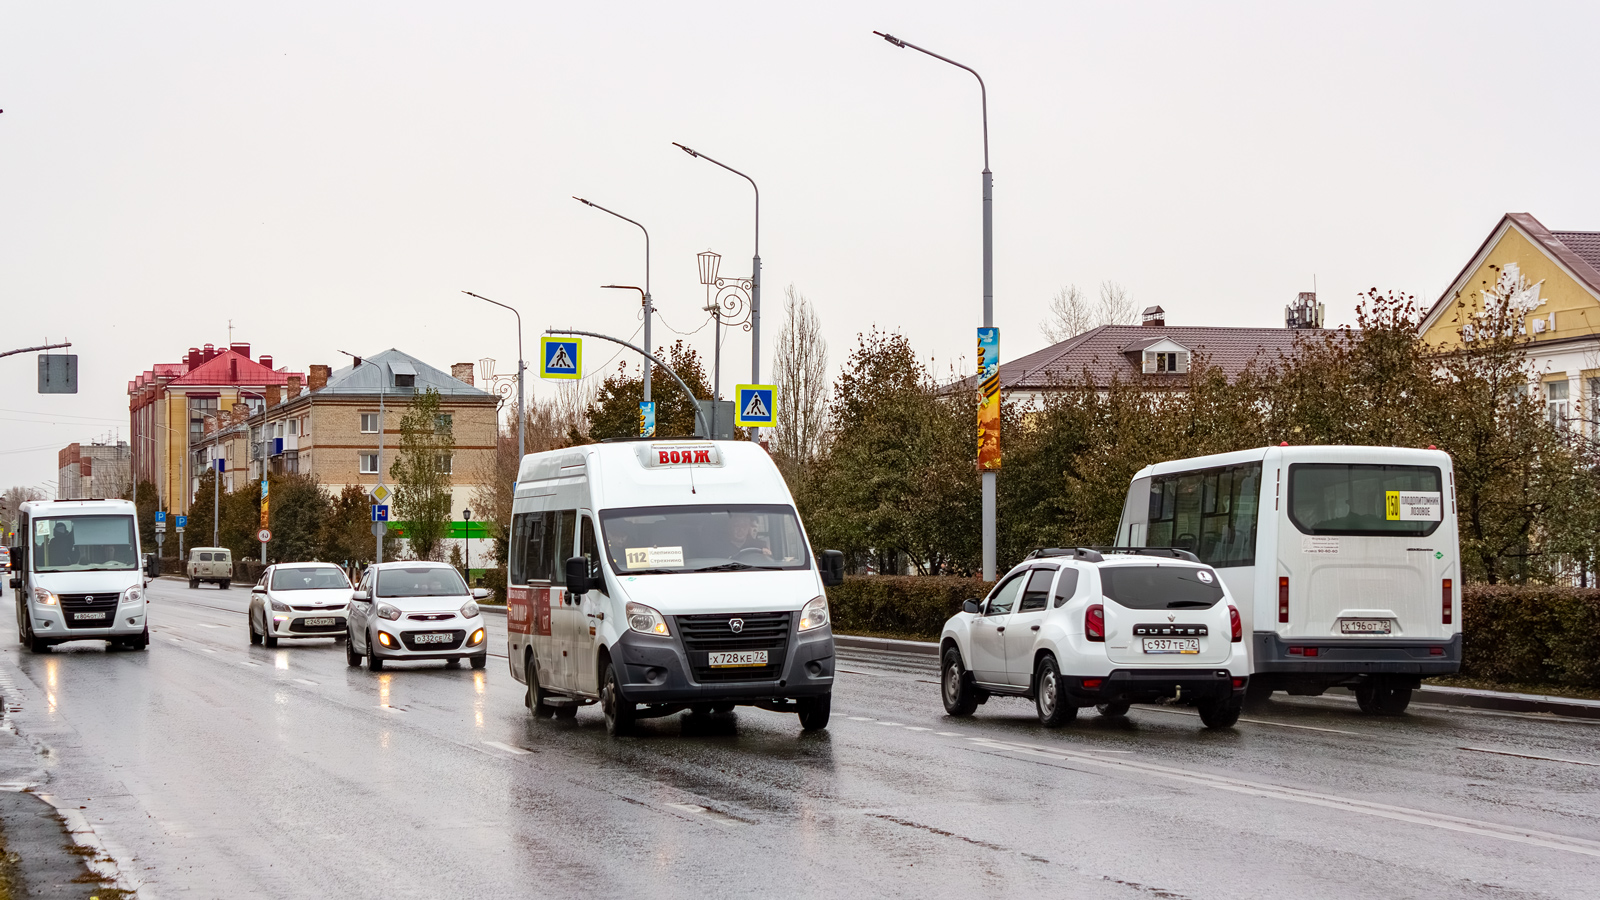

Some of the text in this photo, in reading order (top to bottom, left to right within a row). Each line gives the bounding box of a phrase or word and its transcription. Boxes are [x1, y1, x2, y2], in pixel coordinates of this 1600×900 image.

[658, 450, 711, 464] ВОЯЖ
[1387, 495, 1398, 516] 150
[627, 551, 647, 563] 112
[1147, 639, 1185, 650] С937ТЕ
[712, 653, 752, 664] Х728КЕ
